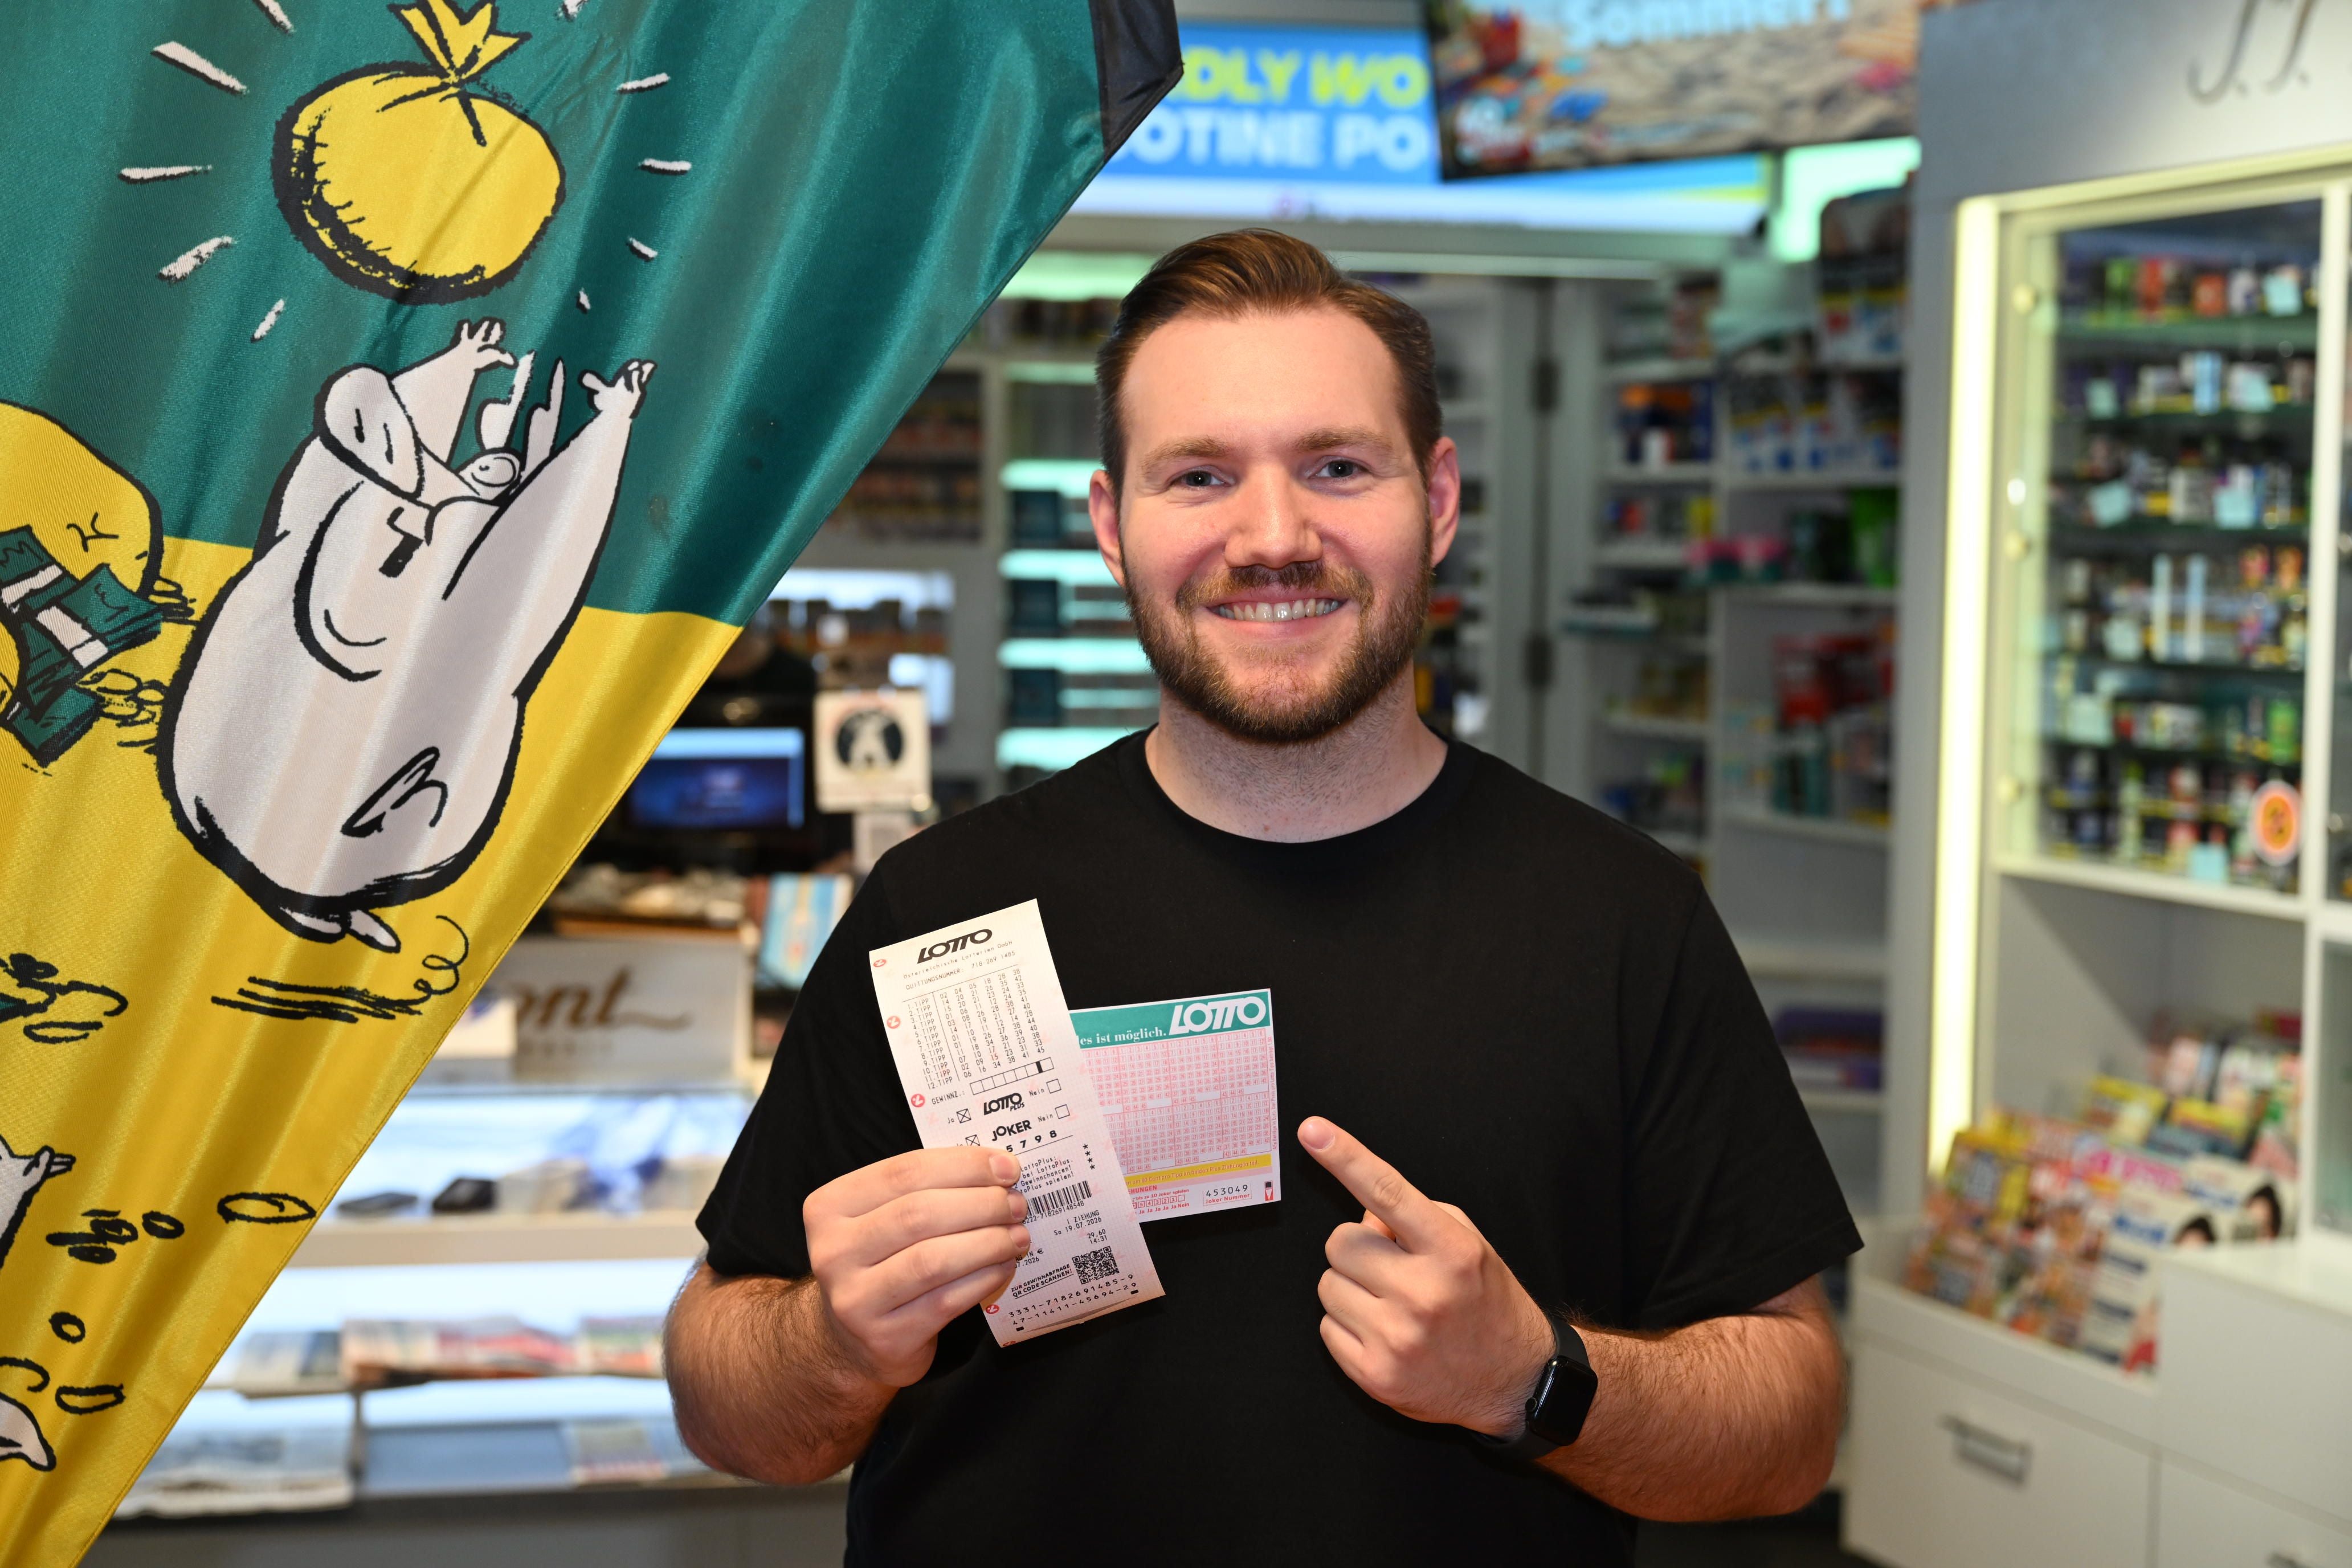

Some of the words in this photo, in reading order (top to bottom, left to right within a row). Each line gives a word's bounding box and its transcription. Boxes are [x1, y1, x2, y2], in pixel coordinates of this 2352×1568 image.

[1169, 46, 1303, 104] DLY
[917, 929, 993, 964] LOTTO
[961, 947, 994, 961] Lotterien
[997, 940, 1013, 950] GmbH
[986, 956, 997, 965] 269
[1001, 951, 1016, 959] 1485
[1169, 996, 1266, 1035] LOTTO
[1096, 1033, 1111, 1044] ist
[1114, 1027, 1167, 1043] möglich.
[983, 1093, 1022, 1115] LOTTO
[1029, 1088, 1044, 1097] Nein
[1010, 1101, 1025, 1112] PLUS
[991, 1120, 1032, 1142] JOKER
[1038, 1113, 1053, 1122] Nein
[1037, 1159, 1073, 1174] LottoPlus.
[1020, 1165, 1072, 1187] Gewinnchancen!
[1046, 1171, 1075, 1186] spielen!
[1206, 1185, 1248, 1197] 453049
[1065, 1216, 1102, 1232] 19.07.2026
[1073, 1210, 1100, 1223] ZIEHUNG
[1087, 1228, 1106, 1239] 29.60
[1089, 1235, 1108, 1245] 14:31
[1011, 1284, 1022, 1292] ZUR
[1023, 1264, 1070, 1287] GEWINNABFRAGE
[1023, 1283, 1040, 1293] CODE
[1041, 1268, 1072, 1285] SCANNEN!
